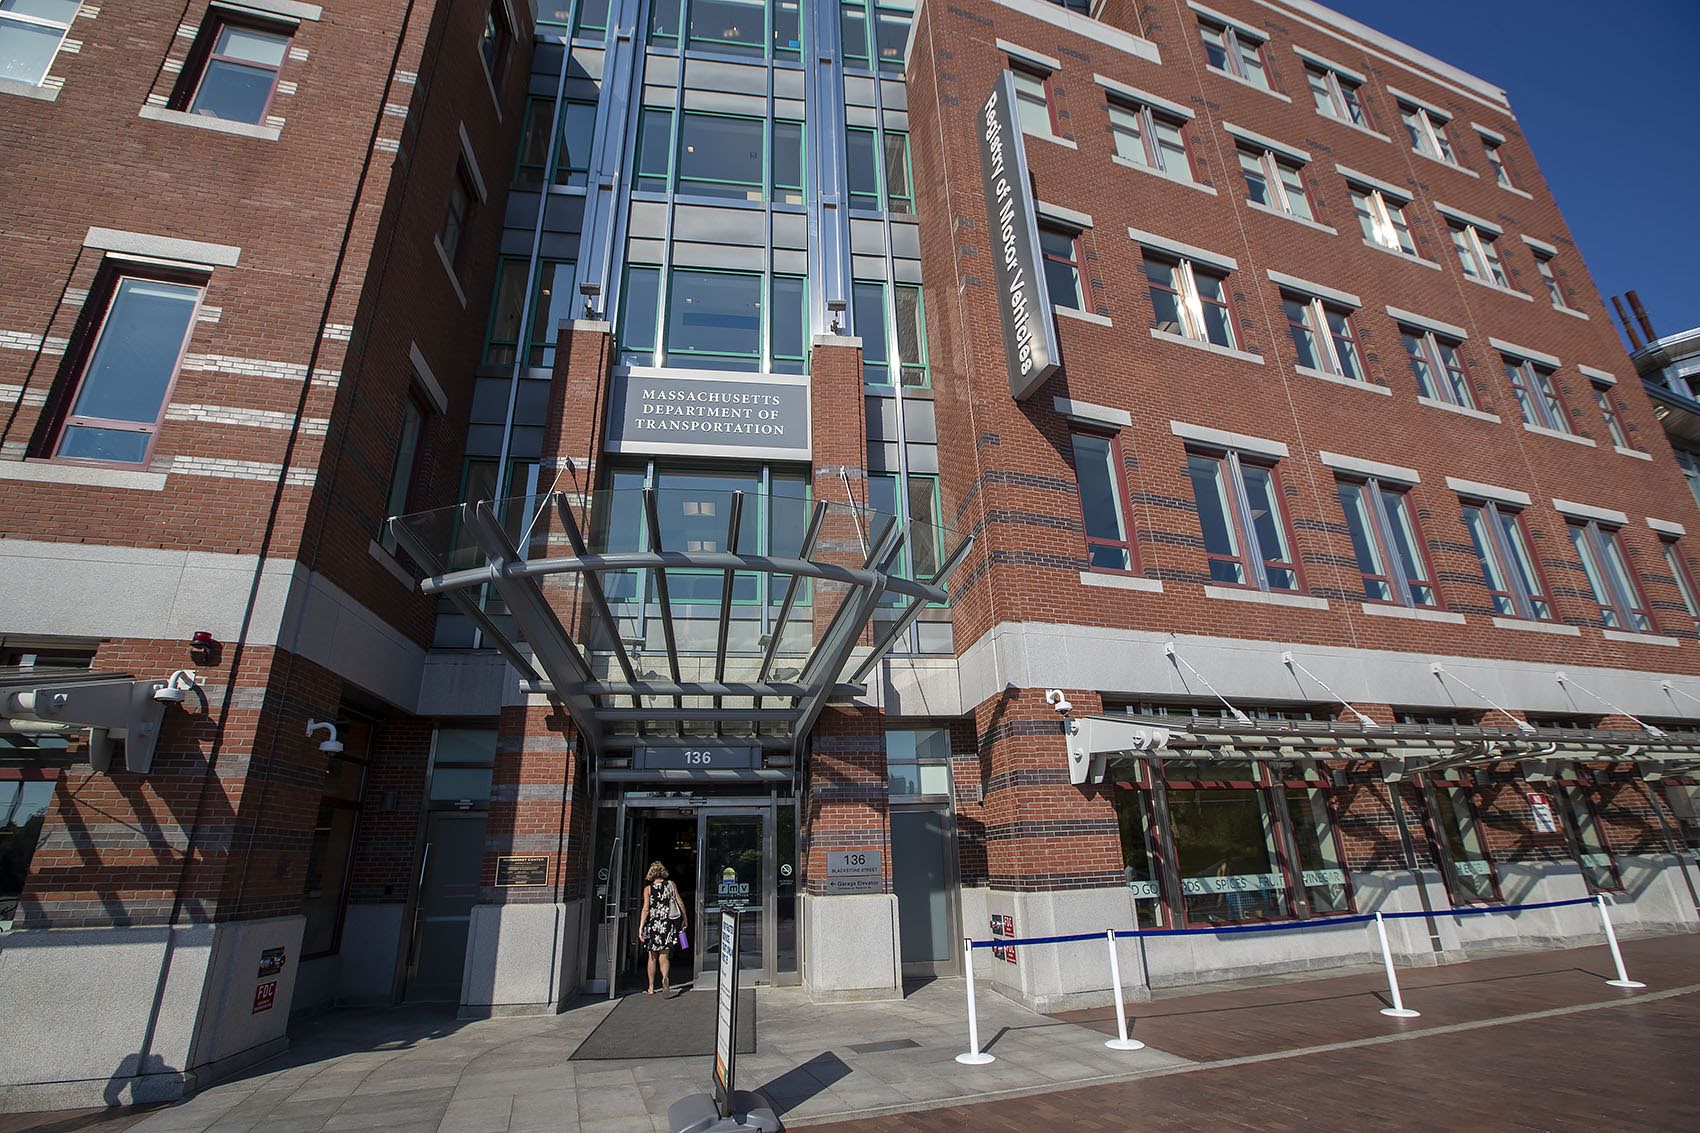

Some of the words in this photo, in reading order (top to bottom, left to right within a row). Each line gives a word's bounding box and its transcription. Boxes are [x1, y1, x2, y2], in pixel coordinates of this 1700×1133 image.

[984, 91, 1004, 180] Registry
[996, 178, 1012, 203] of
[1000, 198, 1019, 271] Motor
[1010, 268, 1033, 376] Vehicles
[642, 389, 780, 406] MASSACHUSETTS
[642, 404, 753, 419] DEPARTMENT
[758, 409, 779, 420] OF
[635, 418, 785, 435] TRANSPORTATION
[684, 751, 712, 764] 136
[844, 854, 866, 866] 136
[719, 884, 749, 893] rmv
[1215, 878, 1247, 891] SPICES
[257, 983, 274, 999] FDC
